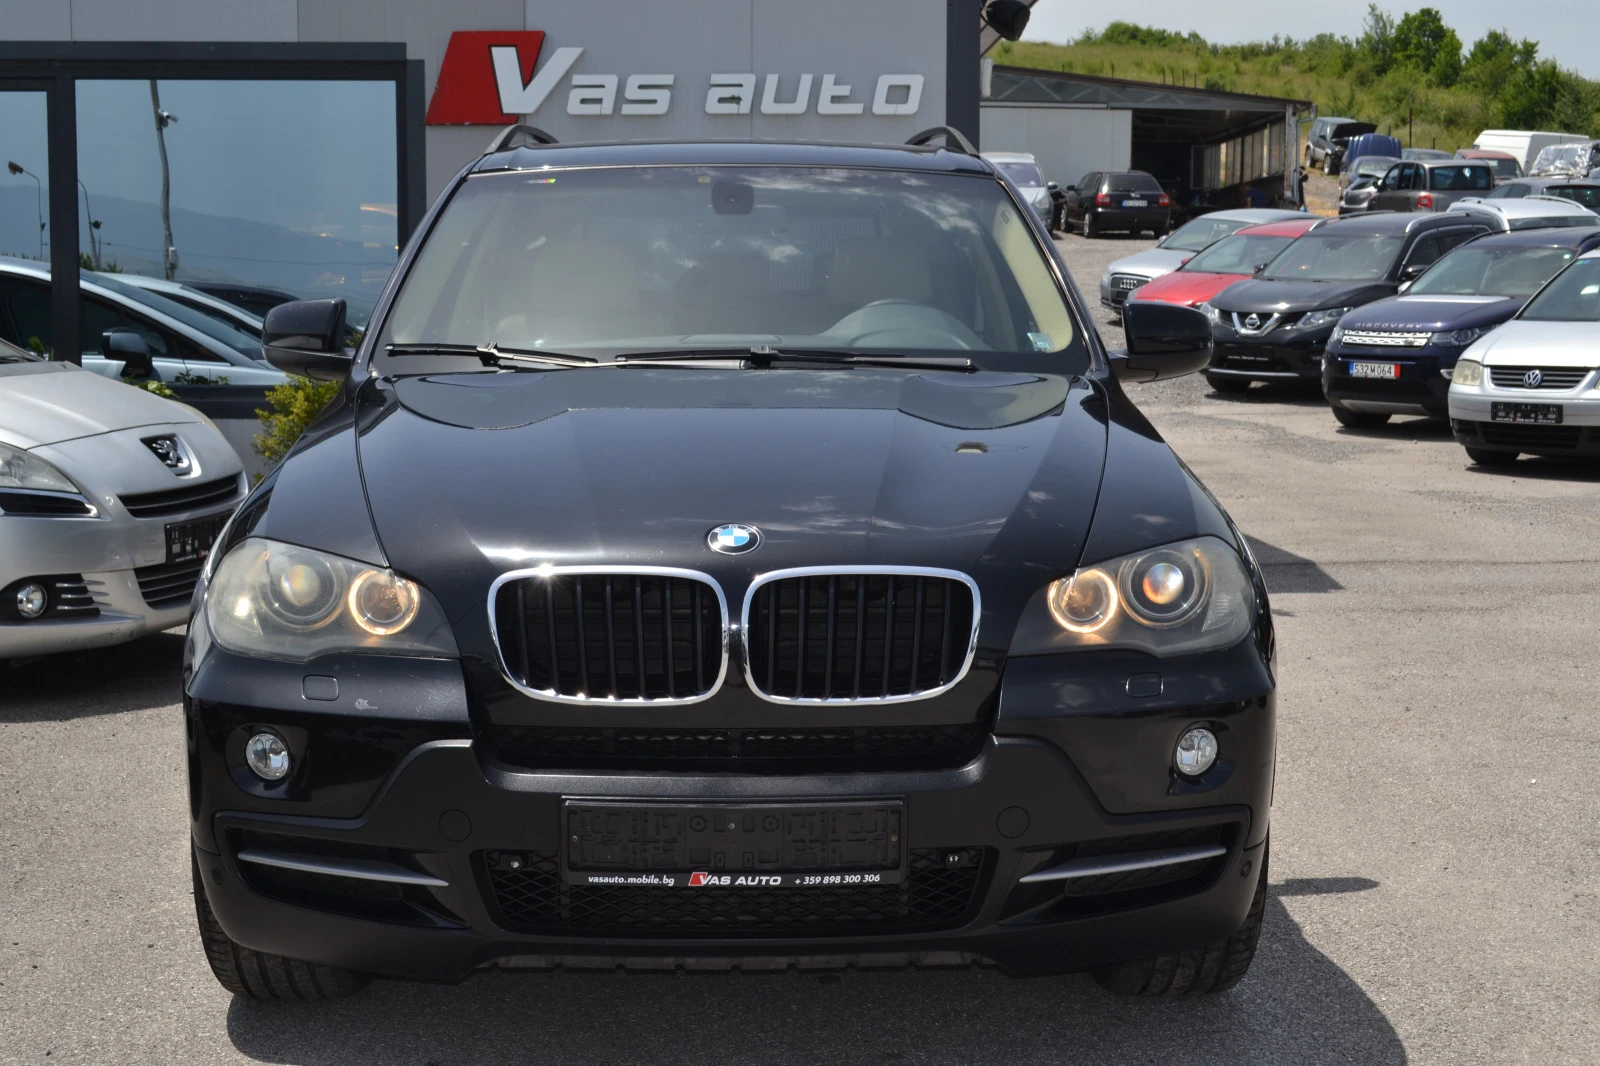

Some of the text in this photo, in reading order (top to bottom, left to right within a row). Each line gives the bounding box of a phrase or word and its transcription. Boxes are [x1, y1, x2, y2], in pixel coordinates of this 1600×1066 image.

[490, 46, 925, 115] Vas auto
[1354, 363, 1392, 376] 532M064
[588, 875, 675, 886] vasauto.mobile.bg
[699, 875, 731, 885] VAS
[735, 876, 782, 886] AUTO
[803, 876, 821, 885] 359
[823, 875, 841, 884] 898
[843, 874, 860, 884] 300
[863, 874, 880, 883] 306
